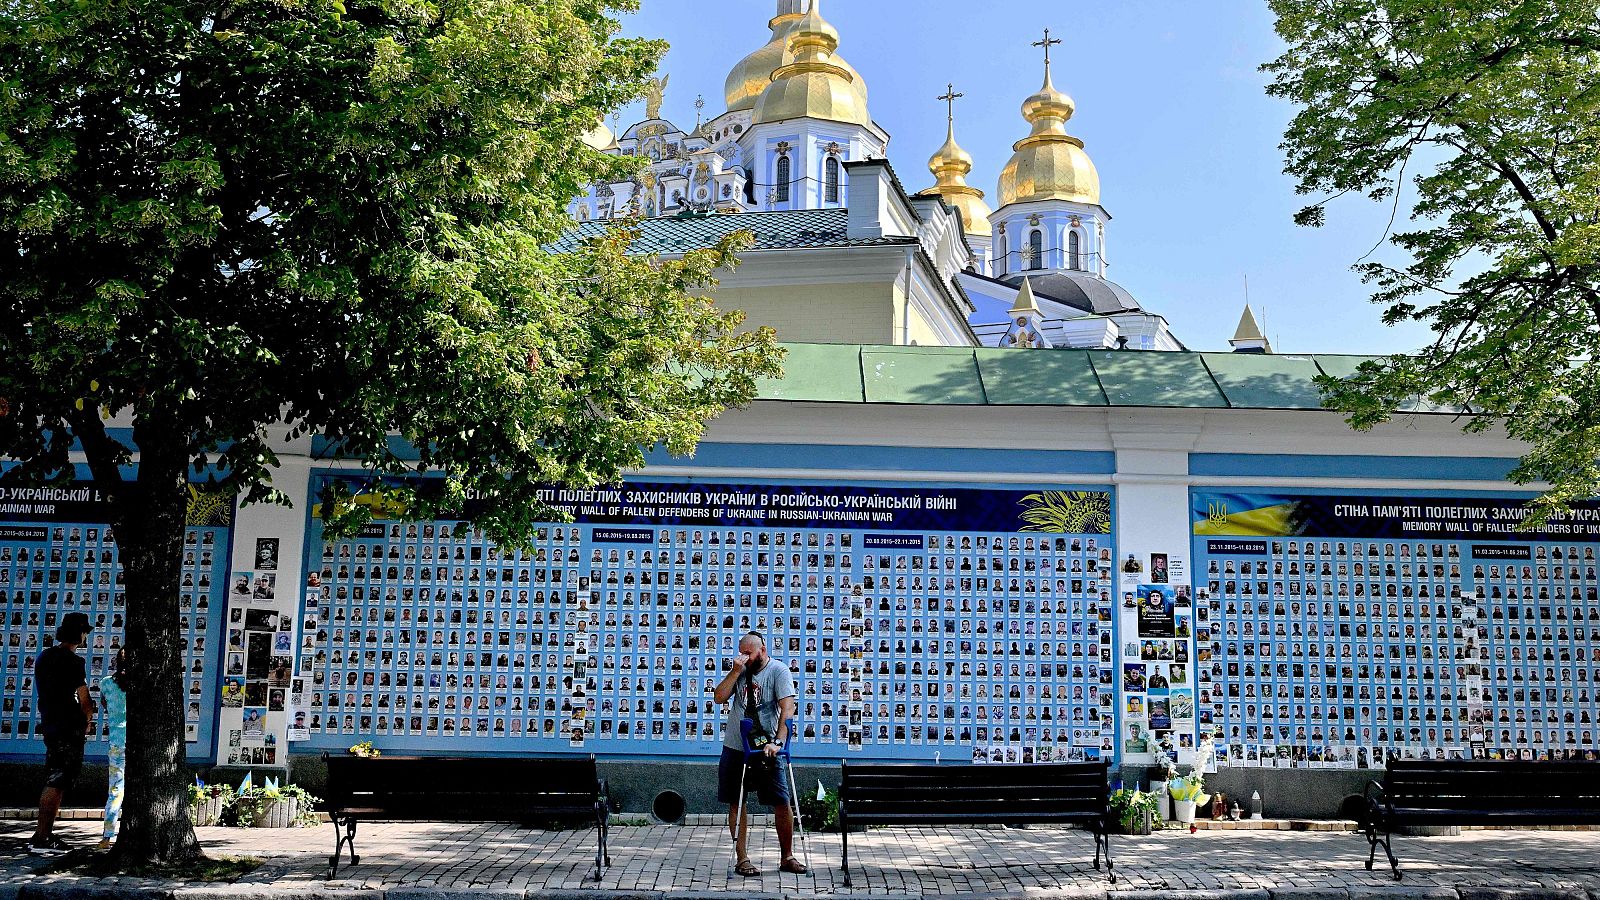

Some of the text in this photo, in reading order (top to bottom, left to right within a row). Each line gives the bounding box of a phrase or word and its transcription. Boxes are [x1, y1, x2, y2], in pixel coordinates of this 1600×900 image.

[558, 489, 622, 503] ПОЛЕГЛИХ
[626, 491, 701, 505] ЗАХИСНИКІВ
[706, 491, 755, 506] УКРАЇНИ
[761, 494, 768, 506] В
[772, 492, 921, 509] РОСІЙСЬКО-УКРАЇНСЬКІЙ
[926, 495, 956, 510] ВІЙНІ
[35, 505, 54, 514] WAR
[581, 506, 605, 516] WALL
[609, 507, 620, 516] OF
[623, 507, 655, 517] FALLEN
[659, 508, 709, 518] DEFENDERS
[713, 509, 724, 518] OF
[727, 509, 765, 519] UKRAINE
[769, 510, 777, 519] IN
[781, 510, 869, 521] RUSSIAN-UKRAINIAN
[872, 512, 892, 522] WAR
[1335, 505, 1369, 517] СТІНА
[1426, 507, 1487, 519] ПОЛЕГЛИХ
[1570, 508, 1600, 521] УКРА
[1403, 522, 1441, 531] MEMORY
[1445, 523, 1469, 532] WALL
[1473, 523, 1483, 532] OF
[1573, 525, 1584, 534] OF
